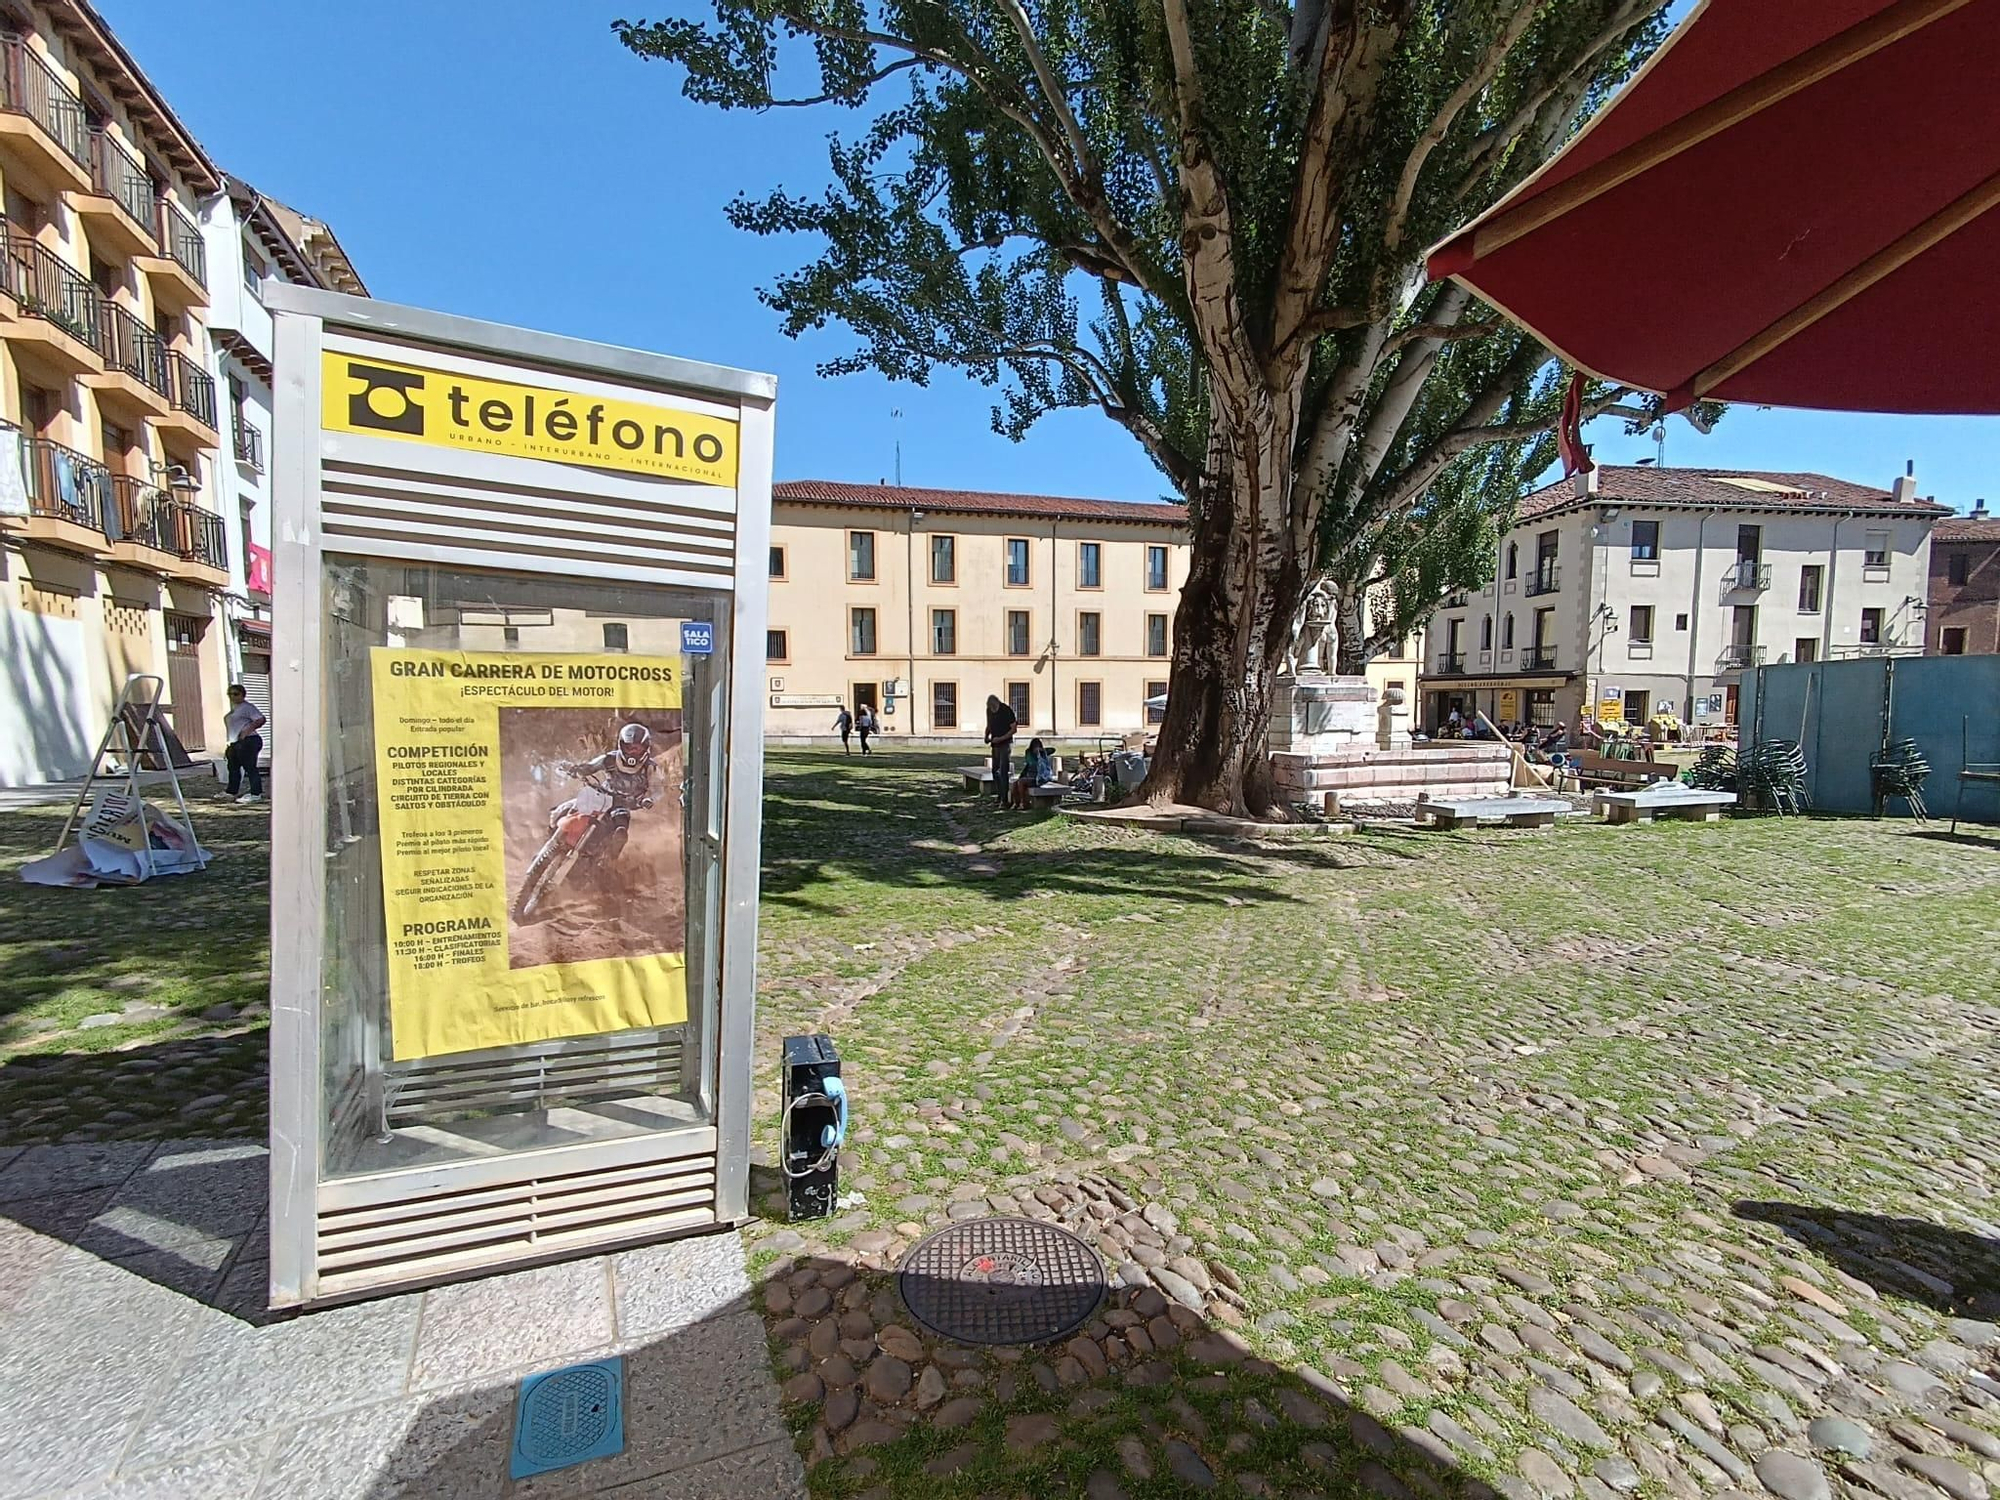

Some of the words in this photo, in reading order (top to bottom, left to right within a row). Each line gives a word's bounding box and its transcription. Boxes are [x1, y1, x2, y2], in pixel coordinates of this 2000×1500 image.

[447, 385, 724, 463] teléfono
[449, 432, 503, 446] URBANO
[524, 444, 611, 461] INTERURBANO
[630, 457, 723, 479] INTERNACIONAL
[684, 630, 709, 638] SALA
[390, 661, 444, 678] GRAN
[450, 663, 536, 680] CARRERA
[542, 665, 563, 680] DE
[568, 665, 672, 682] MOTOCROSS
[460, 685, 546, 698] ¡ESPECTÁCULO
[549, 687, 568, 696] DEL
[572, 687, 614, 697] MOTOR!
[438, 726, 465, 734] popular
[388, 743, 488, 758] COMPETICIÓN
[437, 776, 486, 784] CATEGORÍAS
[435, 800, 486, 808] OBSTÁCULOS
[414, 869, 450, 877] RESPETAR
[421, 876, 469, 885] SEÑALIZADAS
[395, 888, 421, 896] SEGUIR
[423, 885, 473, 894] INDICACIONES
[419, 892, 473, 903] ORGANIZACIÓN
[403, 917, 491, 937] PROGRAMA
[394, 940, 415, 948] 10:00
[432, 931, 501, 944] ENTRENAMIENTOS
[395, 948, 416, 956] 11:30
[434, 939, 500, 952] CLASIFICATORIAS
[452, 948, 484, 957] FINALES
[452, 956, 486, 965] TROFEOS
[963, 1254, 1041, 1285] ALCANTARILADO
